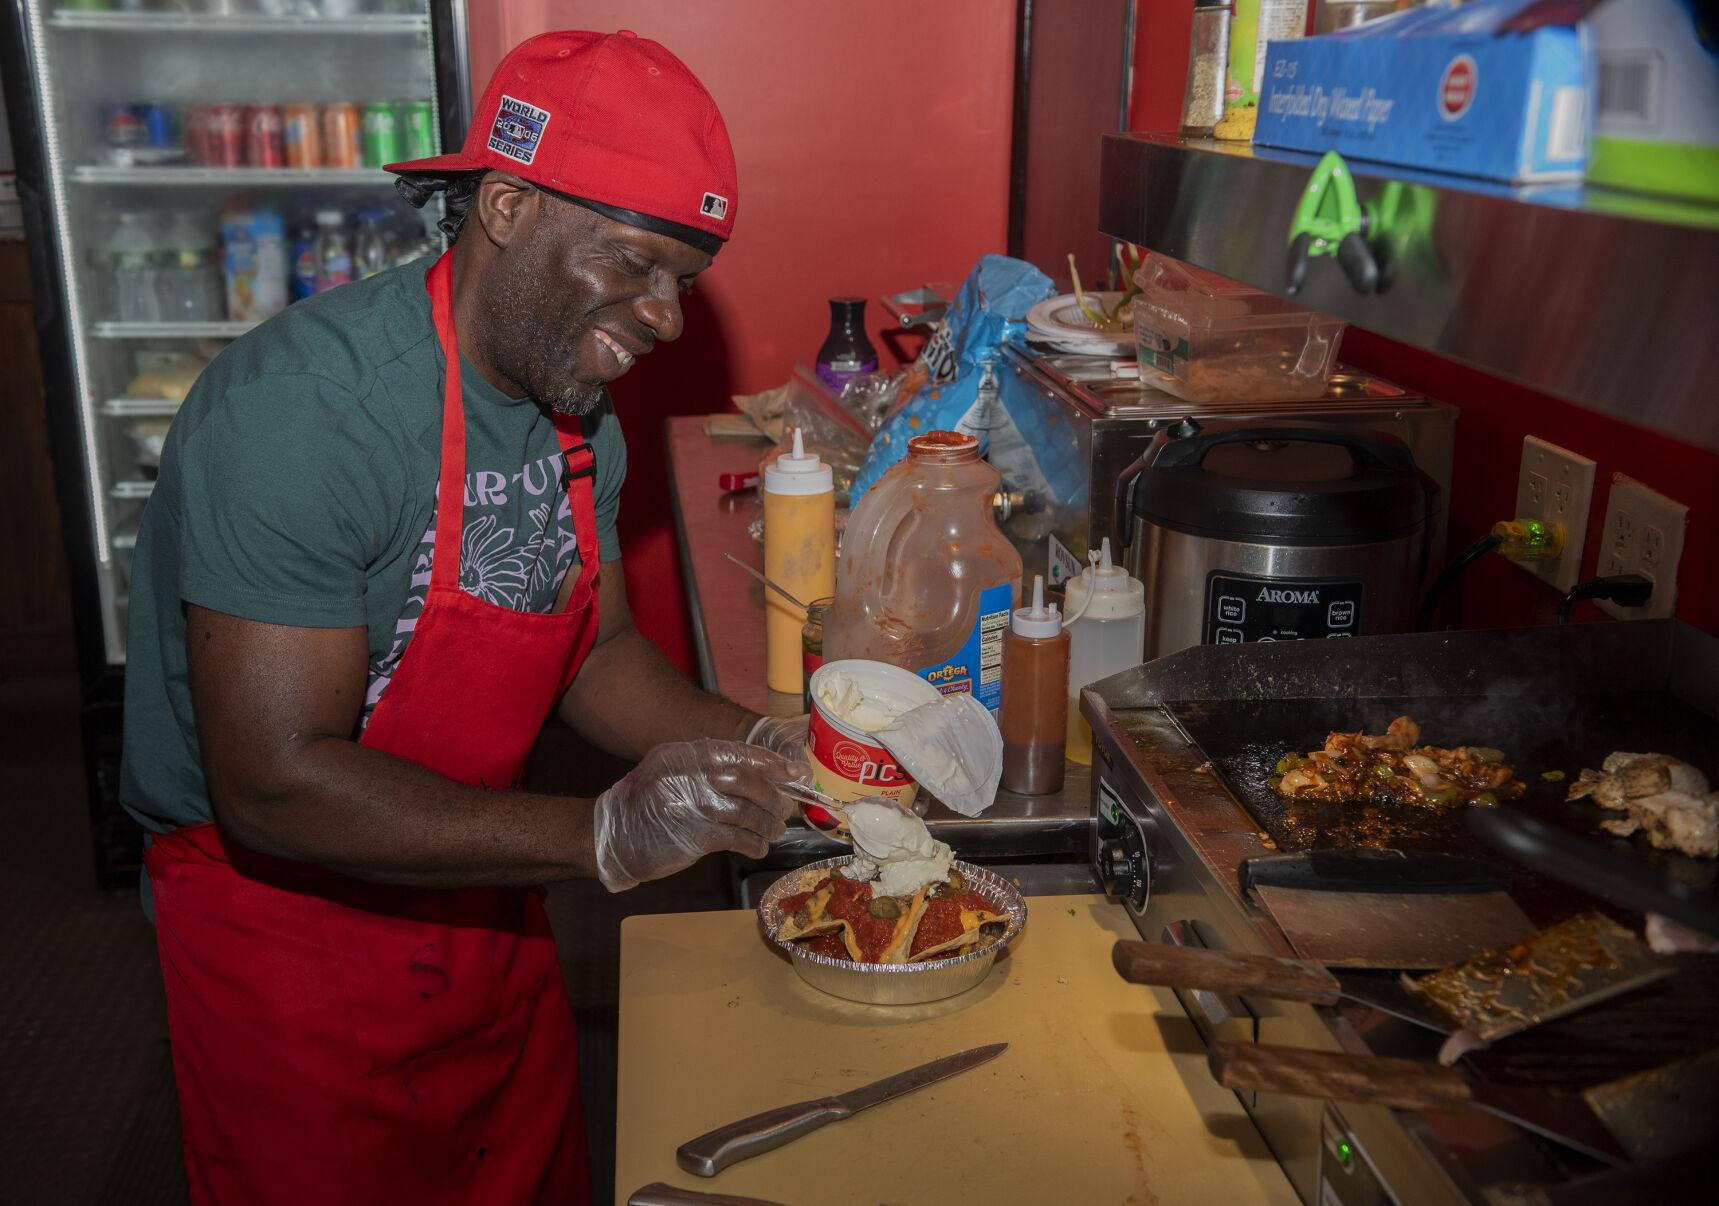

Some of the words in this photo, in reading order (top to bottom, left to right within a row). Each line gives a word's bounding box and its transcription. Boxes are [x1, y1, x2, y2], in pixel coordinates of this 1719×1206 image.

[502, 97, 548, 123] WORLD
[1268, 84, 1314, 123] Interfolded
[488, 137, 533, 162] SERIES
[1223, 605, 1241, 613] white
[1222, 635, 1237, 643] keep
[928, 665, 967, 683] ORTEGA
[835, 751, 859, 765] Quality
[881, 789, 902, 797] PLAIN
